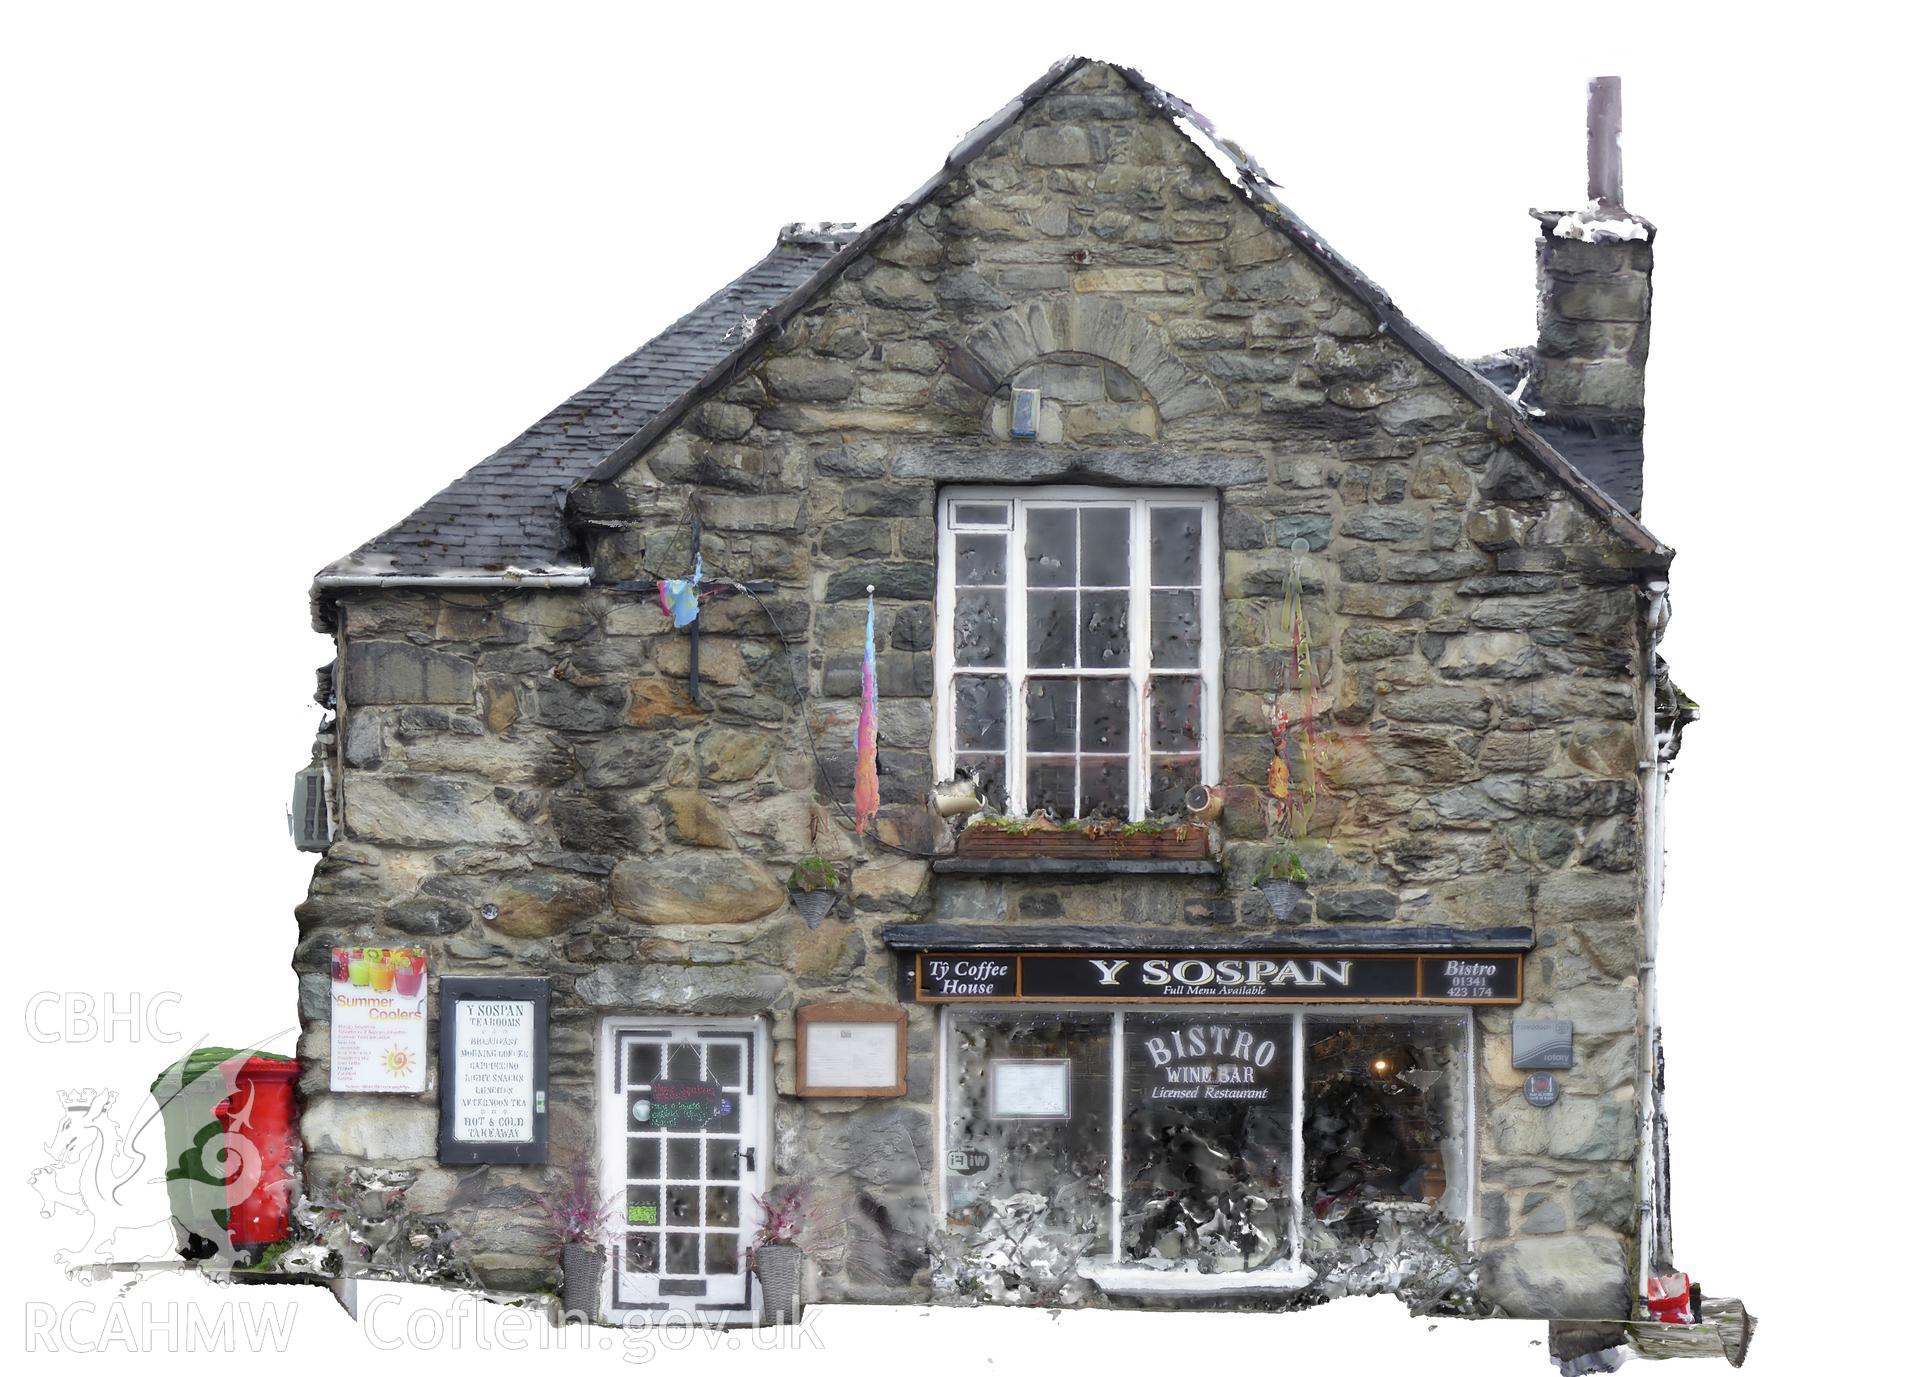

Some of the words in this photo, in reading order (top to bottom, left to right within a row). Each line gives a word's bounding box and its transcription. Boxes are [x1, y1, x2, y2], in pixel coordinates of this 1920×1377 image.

[929, 961, 950, 981] Tŷ
[954, 961, 1008, 981] Coffee
[1089, 959, 1129, 985] Y
[1142, 959, 1353, 986] SOSPAN
[1444, 960, 1497, 976] Bistro
[941, 979, 994, 994] House
[1452, 977, 1487, 987] 01341
[1163, 986, 1183, 995] Full
[1187, 986, 1216, 995] Menu
[1219, 986, 1266, 996] Available
[1447, 987, 1469, 997] 423
[1472, 987, 1493, 997] 174
[336, 994, 395, 1008] Summer
[368, 1007, 422, 1021] Coolers
[467, 1005, 474, 1016] Y
[478, 1005, 524, 1016] SOSPAN
[470, 1018, 521, 1027] TEAROOMS
[1144, 1025, 1275, 1068] BISTRO
[1165, 1066, 1214, 1083] WINE
[1217, 1065, 1254, 1083] BAR
[1152, 1086, 1199, 1099] Licensed
[1205, 1087, 1268, 1099] Restaurant
[511, 1099, 527, 1107] TEA
[464, 1117, 485, 1126] HOT
[489, 1117, 494, 1127] &
[498, 1117, 524, 1127] COLD
